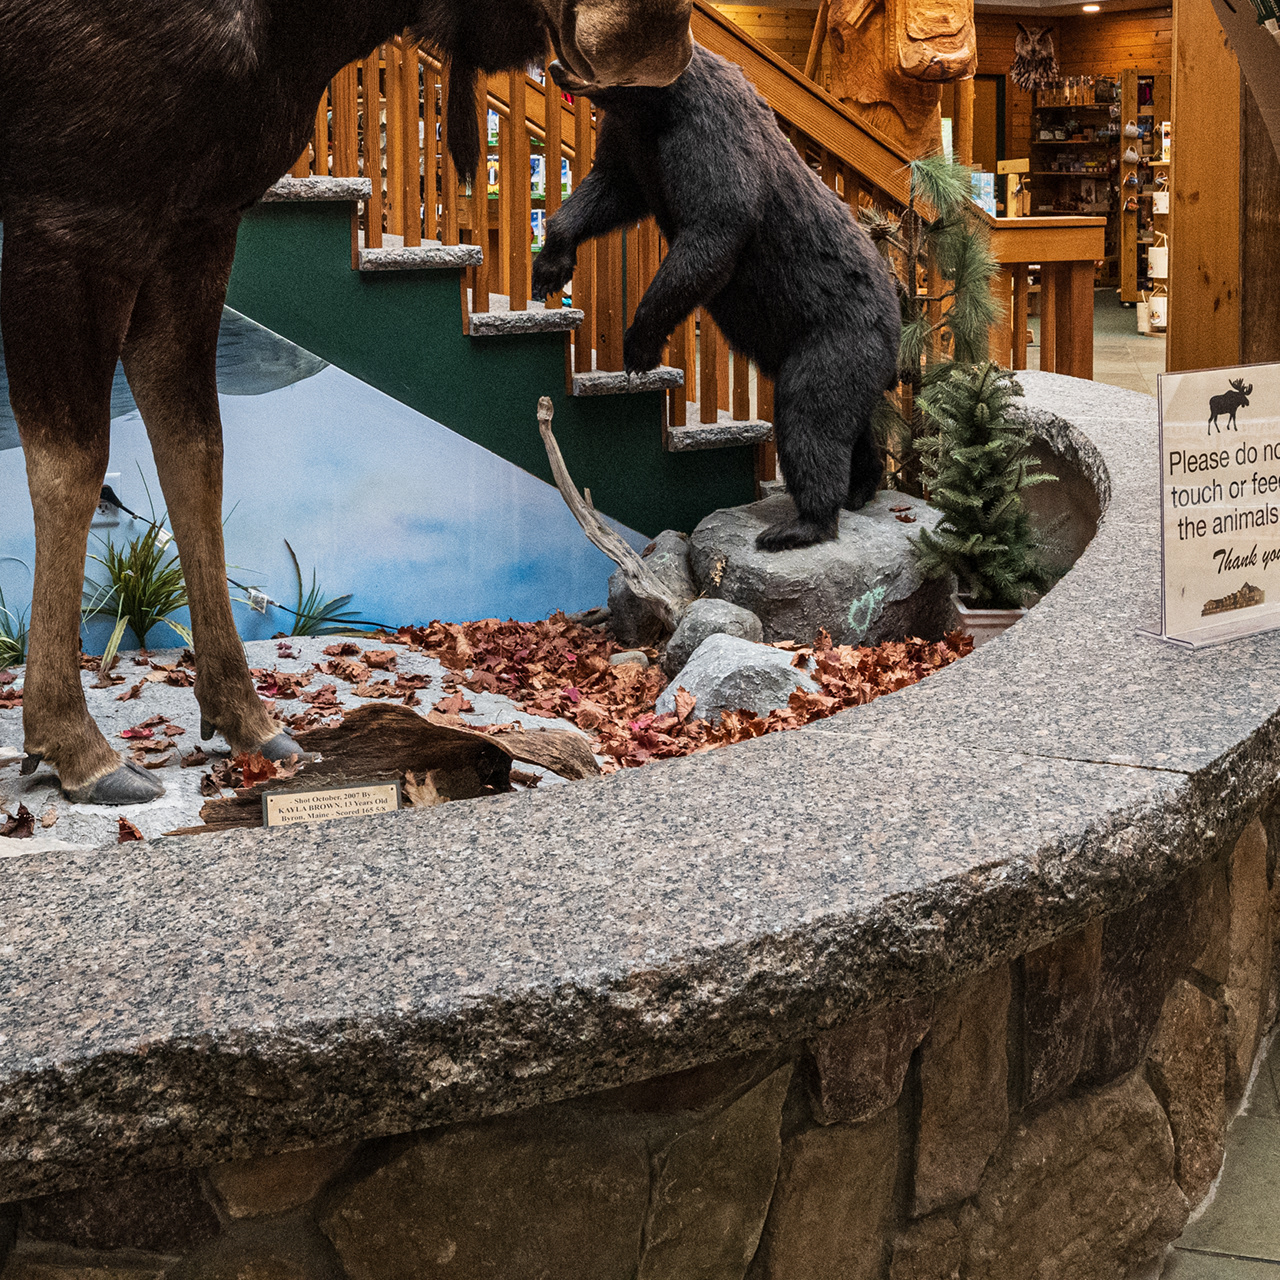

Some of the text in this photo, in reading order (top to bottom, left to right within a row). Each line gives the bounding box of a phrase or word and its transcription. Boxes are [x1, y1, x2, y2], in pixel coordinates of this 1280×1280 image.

[1170, 449, 1229, 475] Please
[1235, 442, 1258, 466] do
[1171, 479, 1222, 508] touch
[1229, 480, 1248, 500] or
[1178, 516, 1207, 540] the
[1213, 544, 1258, 574] Thank
[278, 797, 388, 814] KAYLA BROWN, 13 Years Old
[294, 796, 311, 804] Shot
[312, 793, 343, 804] October,
[344, 792, 360, 800] 2007
[361, 791, 371, 799] By
[281, 813, 304, 823] Byron,
[307, 811, 329, 819] Maine
[336, 808, 360, 817] Scored
[362, 807, 374, 815] 165
